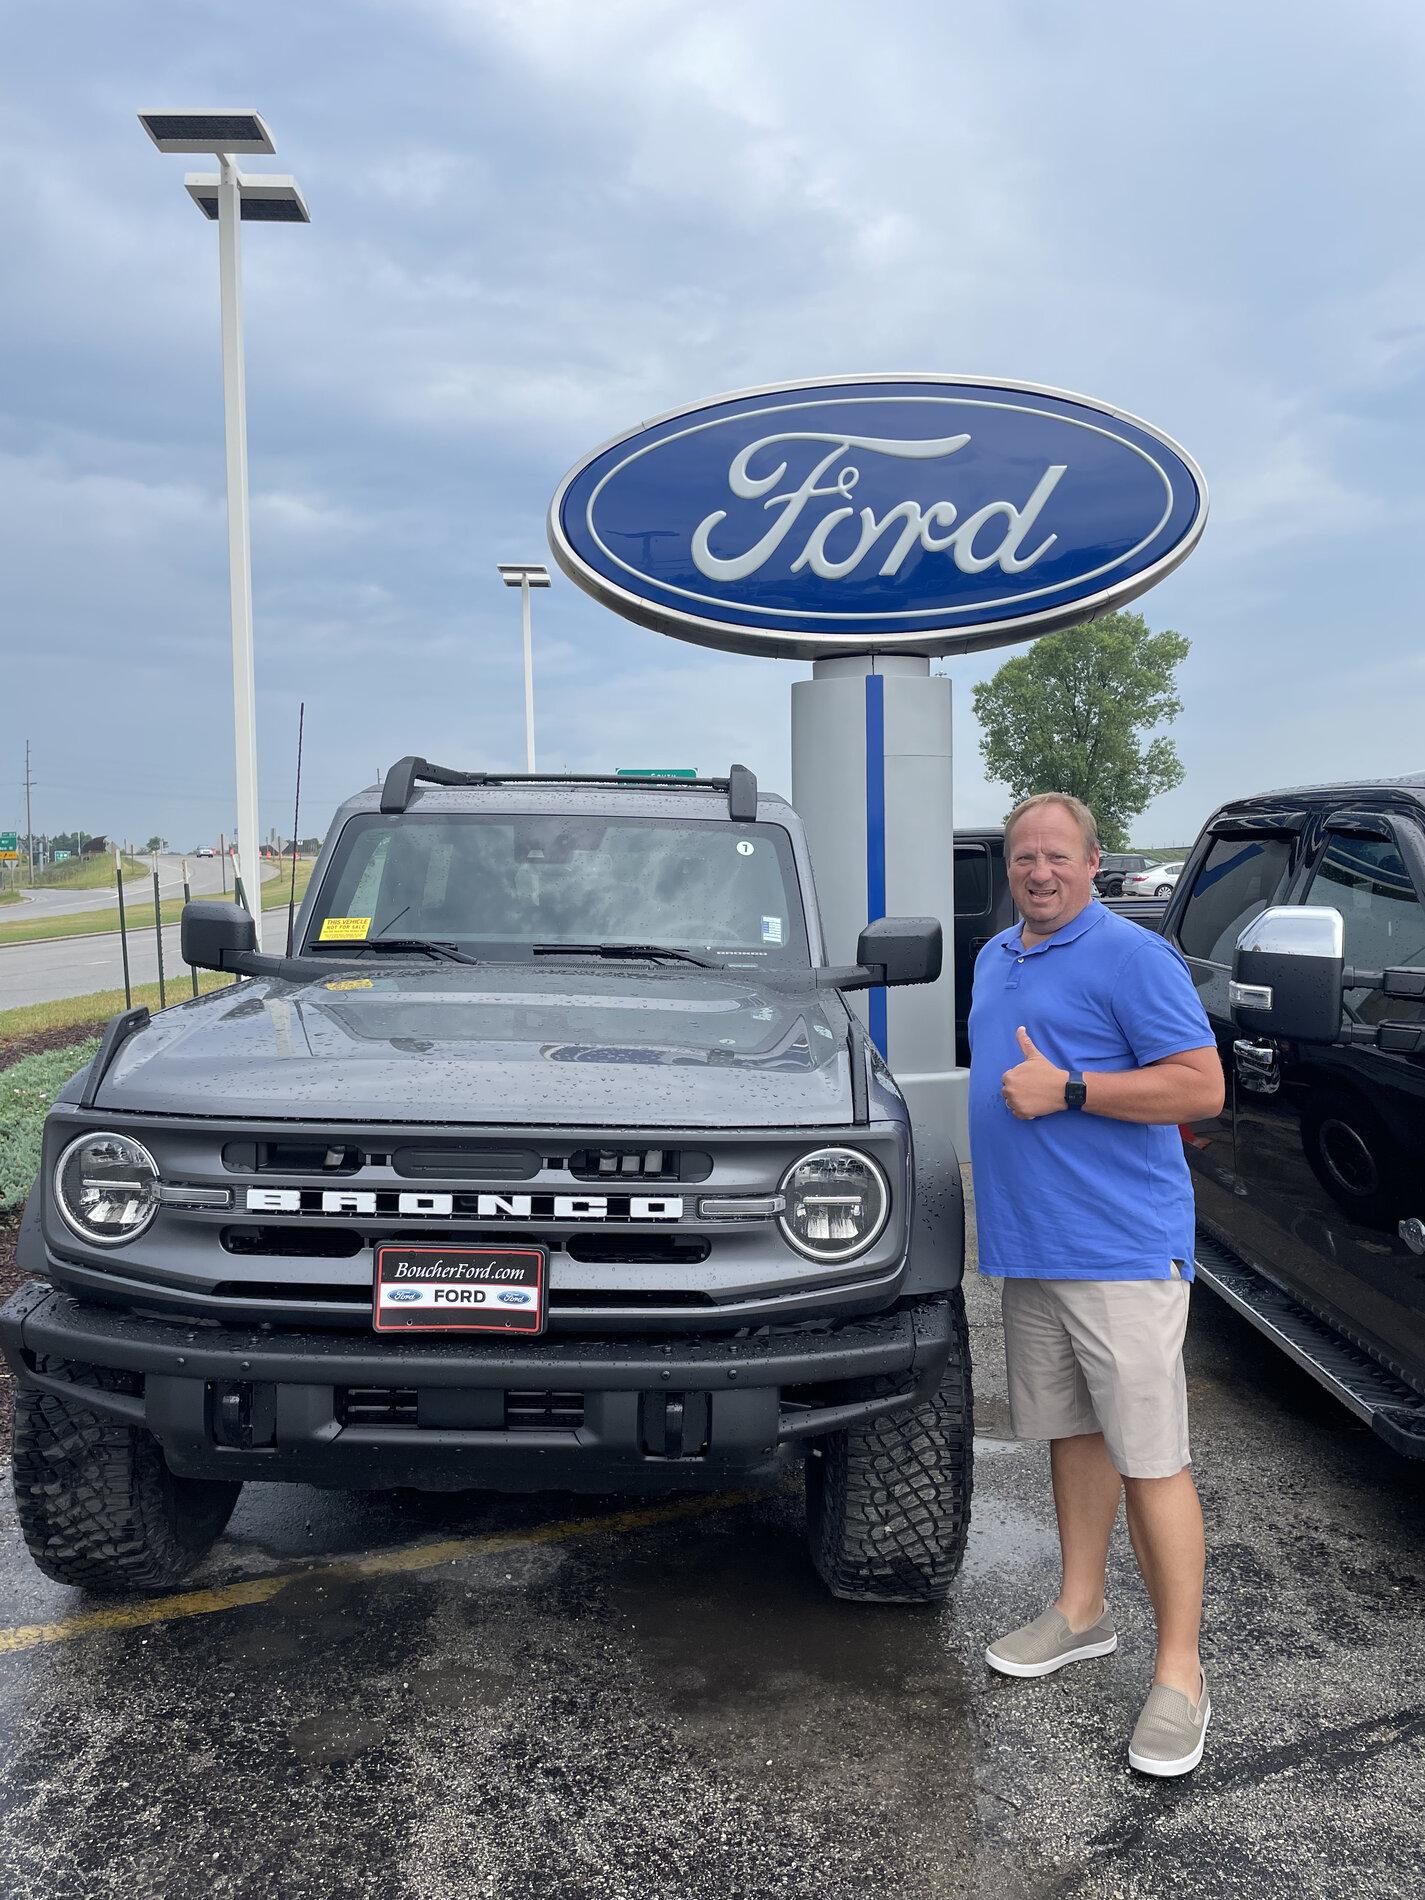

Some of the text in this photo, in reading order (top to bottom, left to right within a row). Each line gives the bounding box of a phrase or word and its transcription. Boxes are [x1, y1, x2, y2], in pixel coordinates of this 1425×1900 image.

[691, 432, 1068, 582] Ford
[247, 1189, 683, 1218] BRONCO
[395, 1260, 525, 1280] BoucherFord.com
[434, 1289, 487, 1303] FORD
